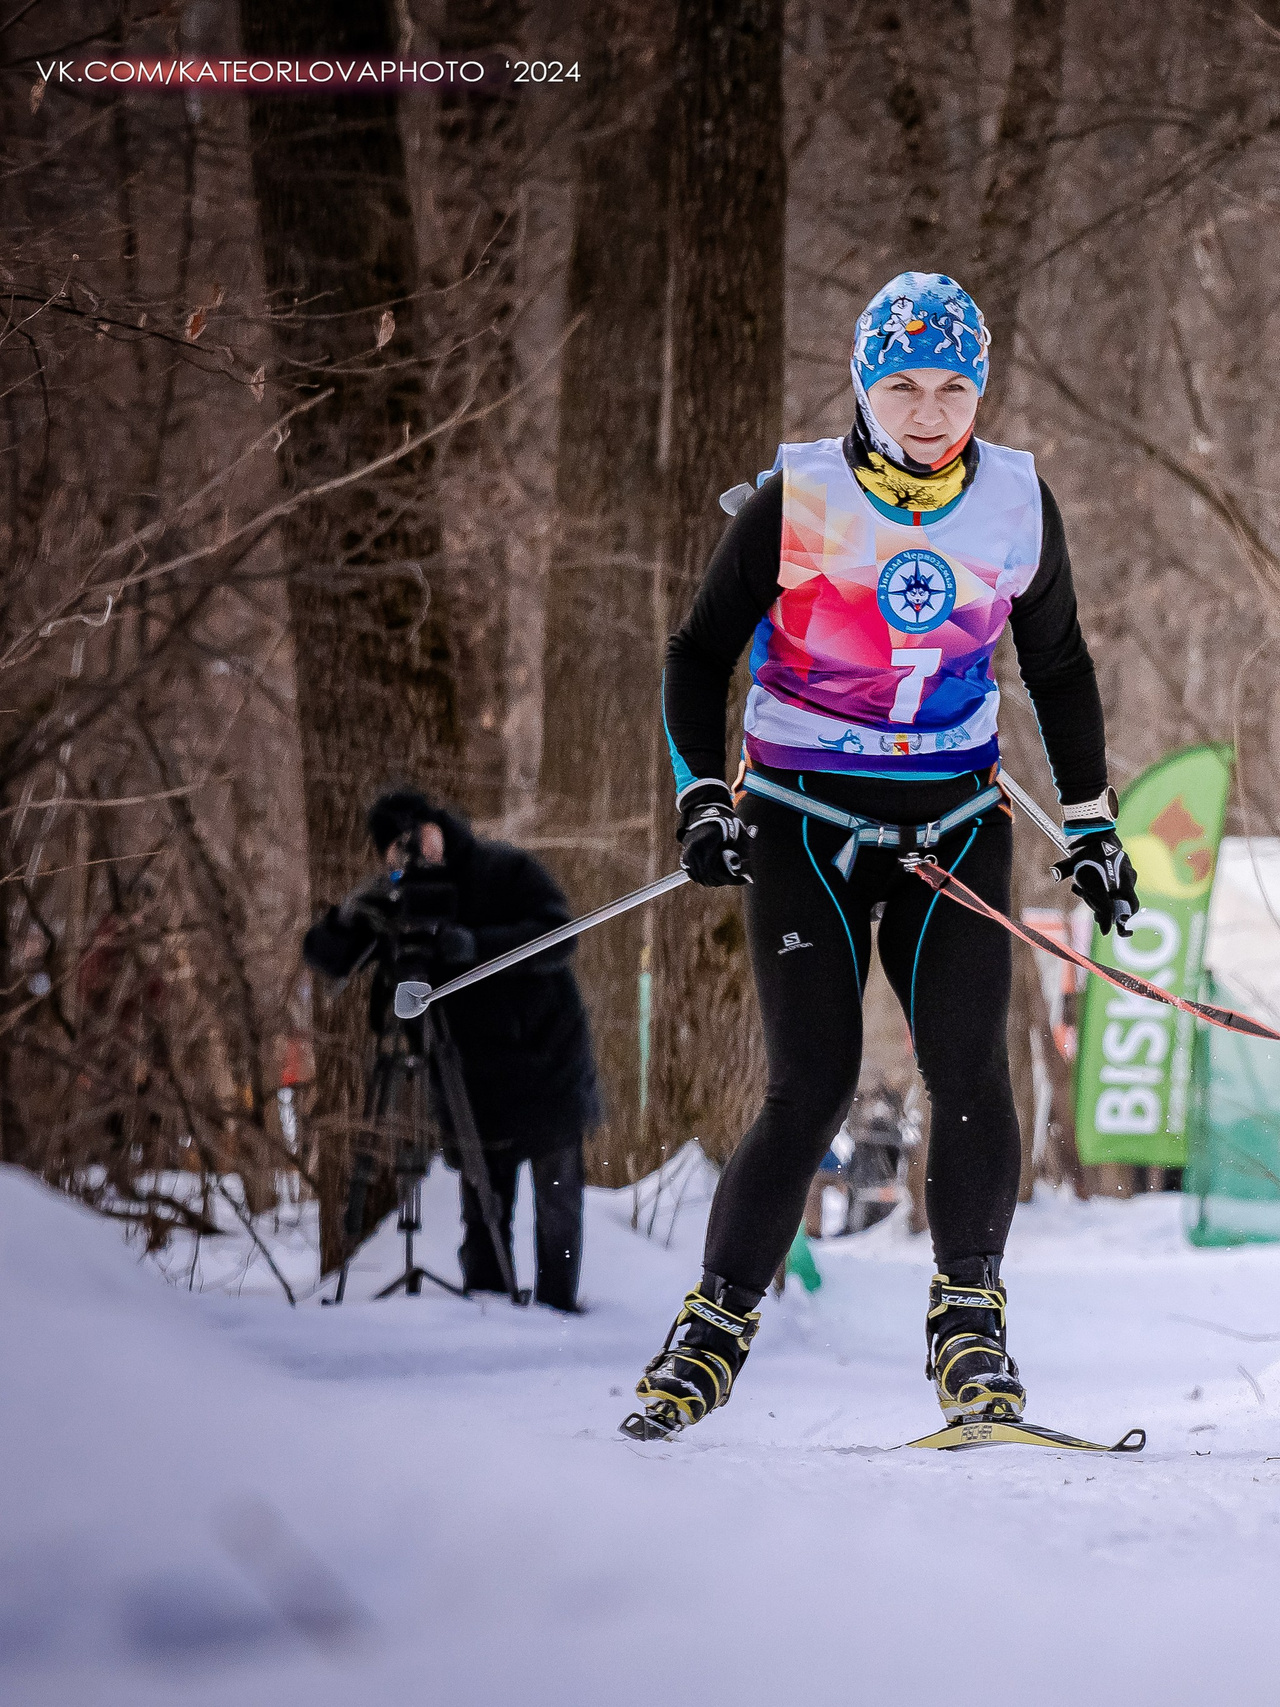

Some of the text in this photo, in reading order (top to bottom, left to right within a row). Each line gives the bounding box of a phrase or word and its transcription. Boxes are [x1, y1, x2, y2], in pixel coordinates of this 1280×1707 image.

[889, 648, 943, 724] 7
[1095, 907, 1182, 1135] BISKO
[689, 1302, 745, 1336] FISCHE
[941, 1294, 992, 1307] SCHER
